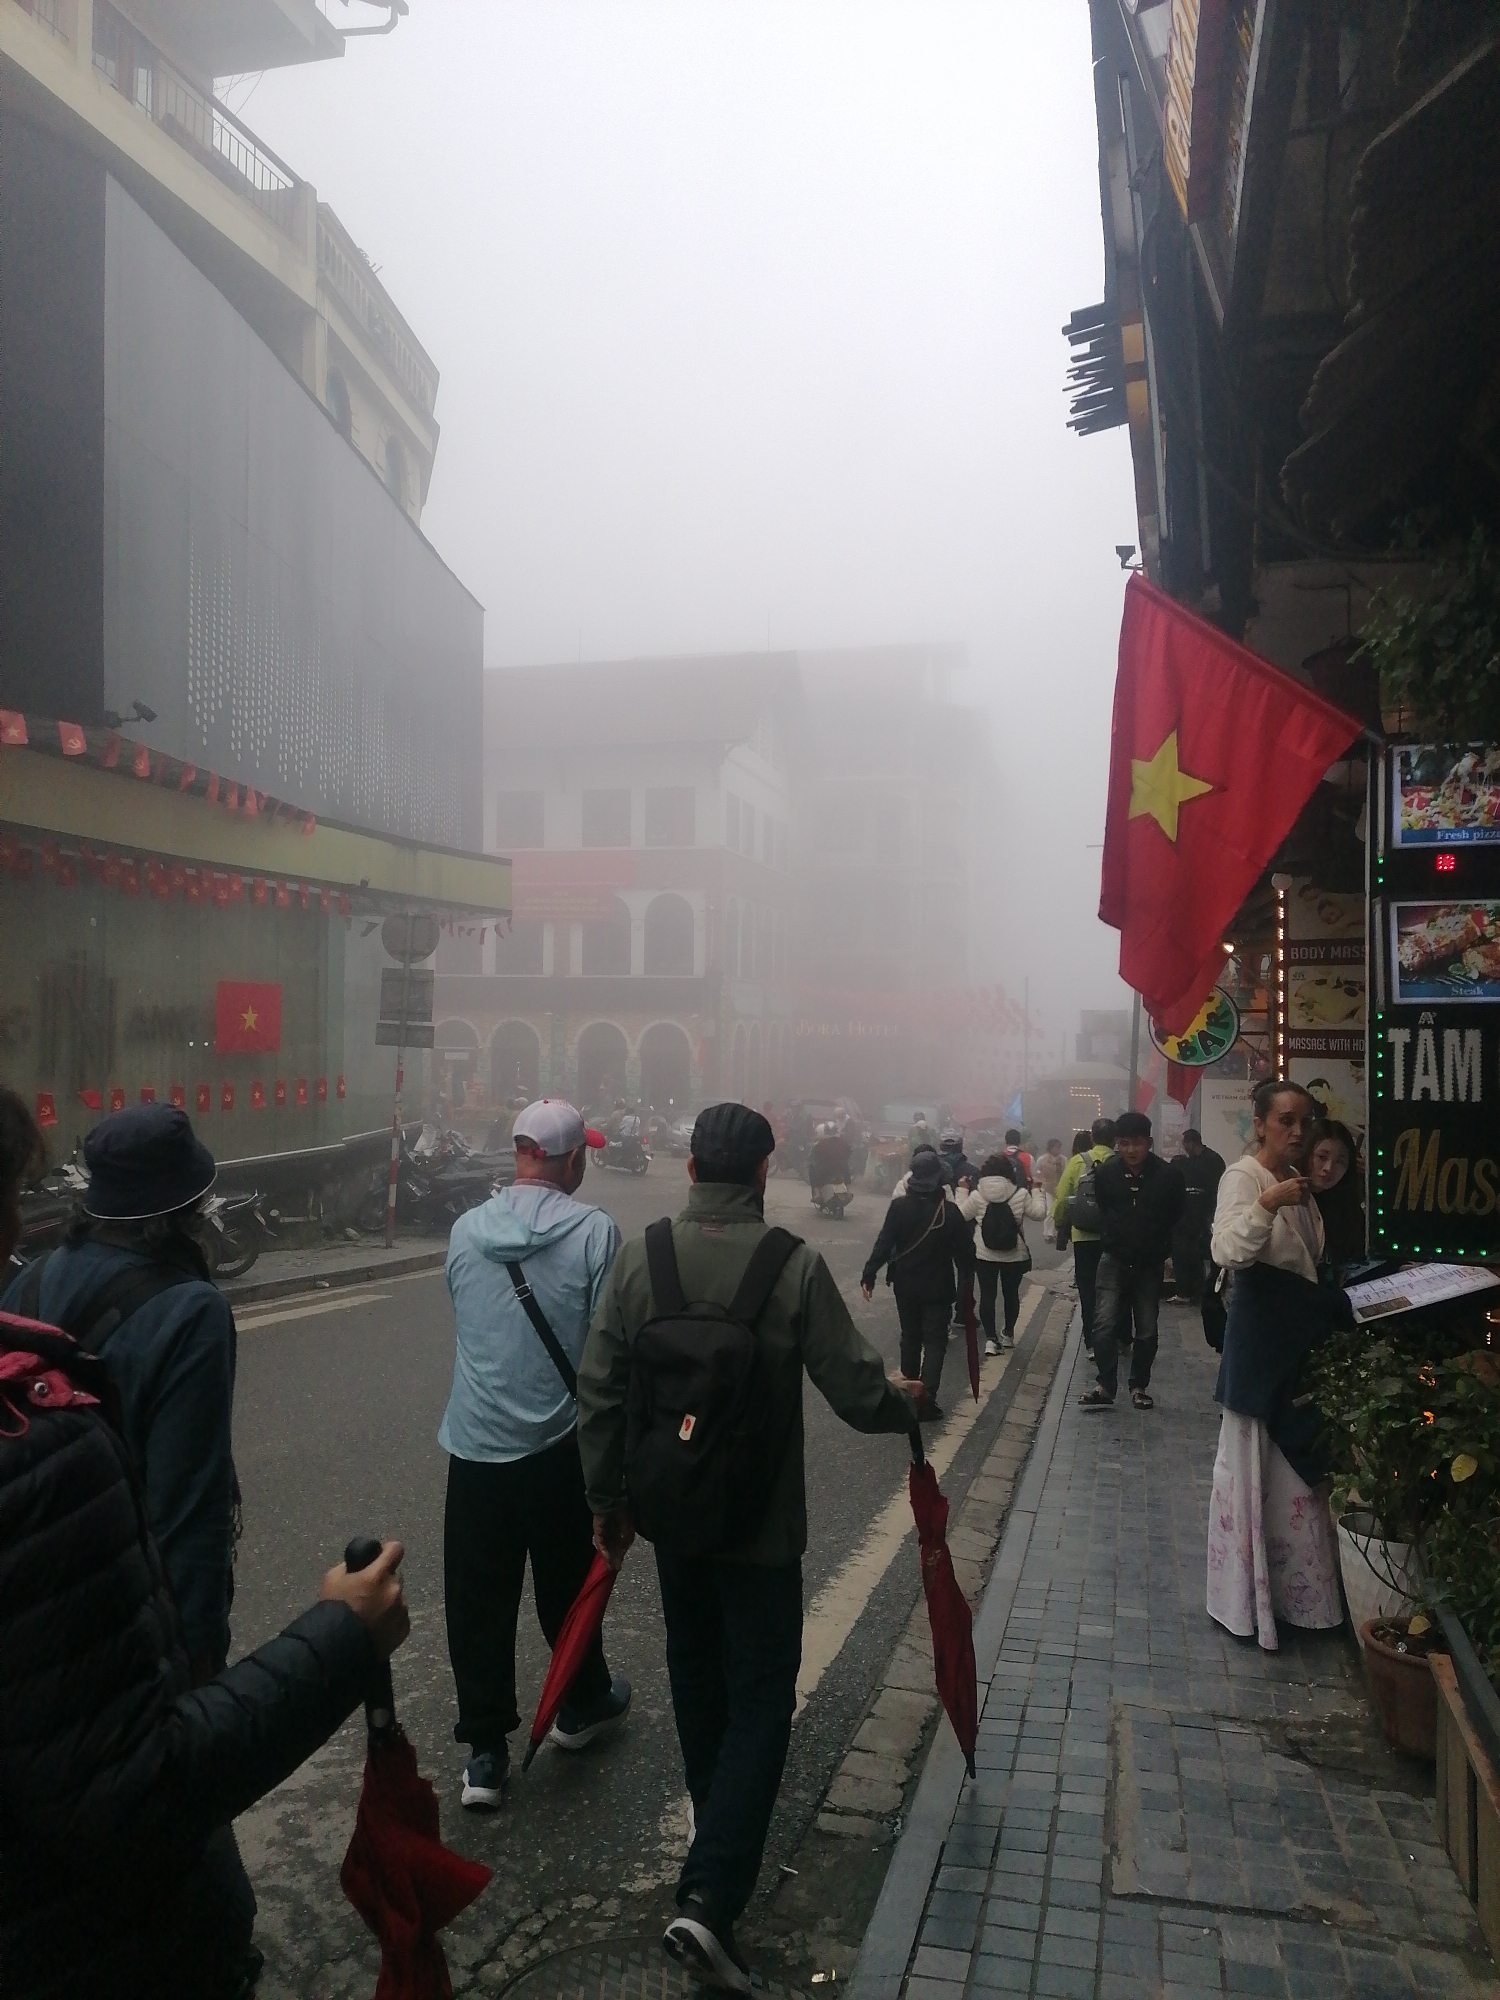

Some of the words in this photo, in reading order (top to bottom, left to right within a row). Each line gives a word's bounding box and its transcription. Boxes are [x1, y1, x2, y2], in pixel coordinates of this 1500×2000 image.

[1437, 830, 1470, 840] Fresh
[1290, 947, 1326, 960] BODY
[1450, 986, 1484, 996] Steak
[1288, 1037, 1327, 1050] MASSAGE
[1329, 1038, 1351, 1051] WITH
